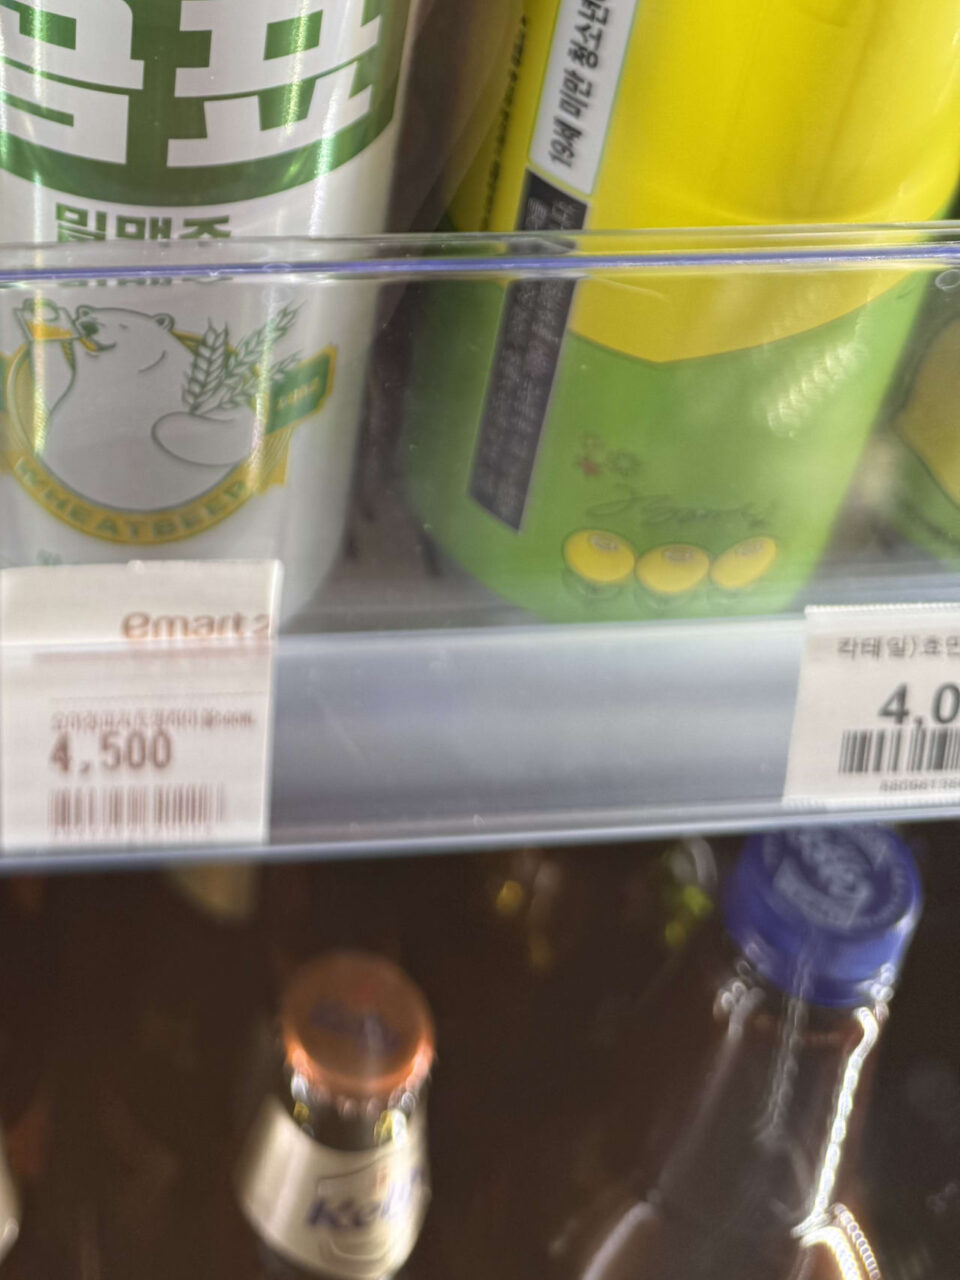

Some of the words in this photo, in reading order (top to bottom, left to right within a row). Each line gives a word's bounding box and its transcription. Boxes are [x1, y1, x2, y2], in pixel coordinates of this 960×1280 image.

[558, 67, 594, 120] 미만
[547, 115, 583, 169] 19세
[49, 730, 174, 774] 4,500
